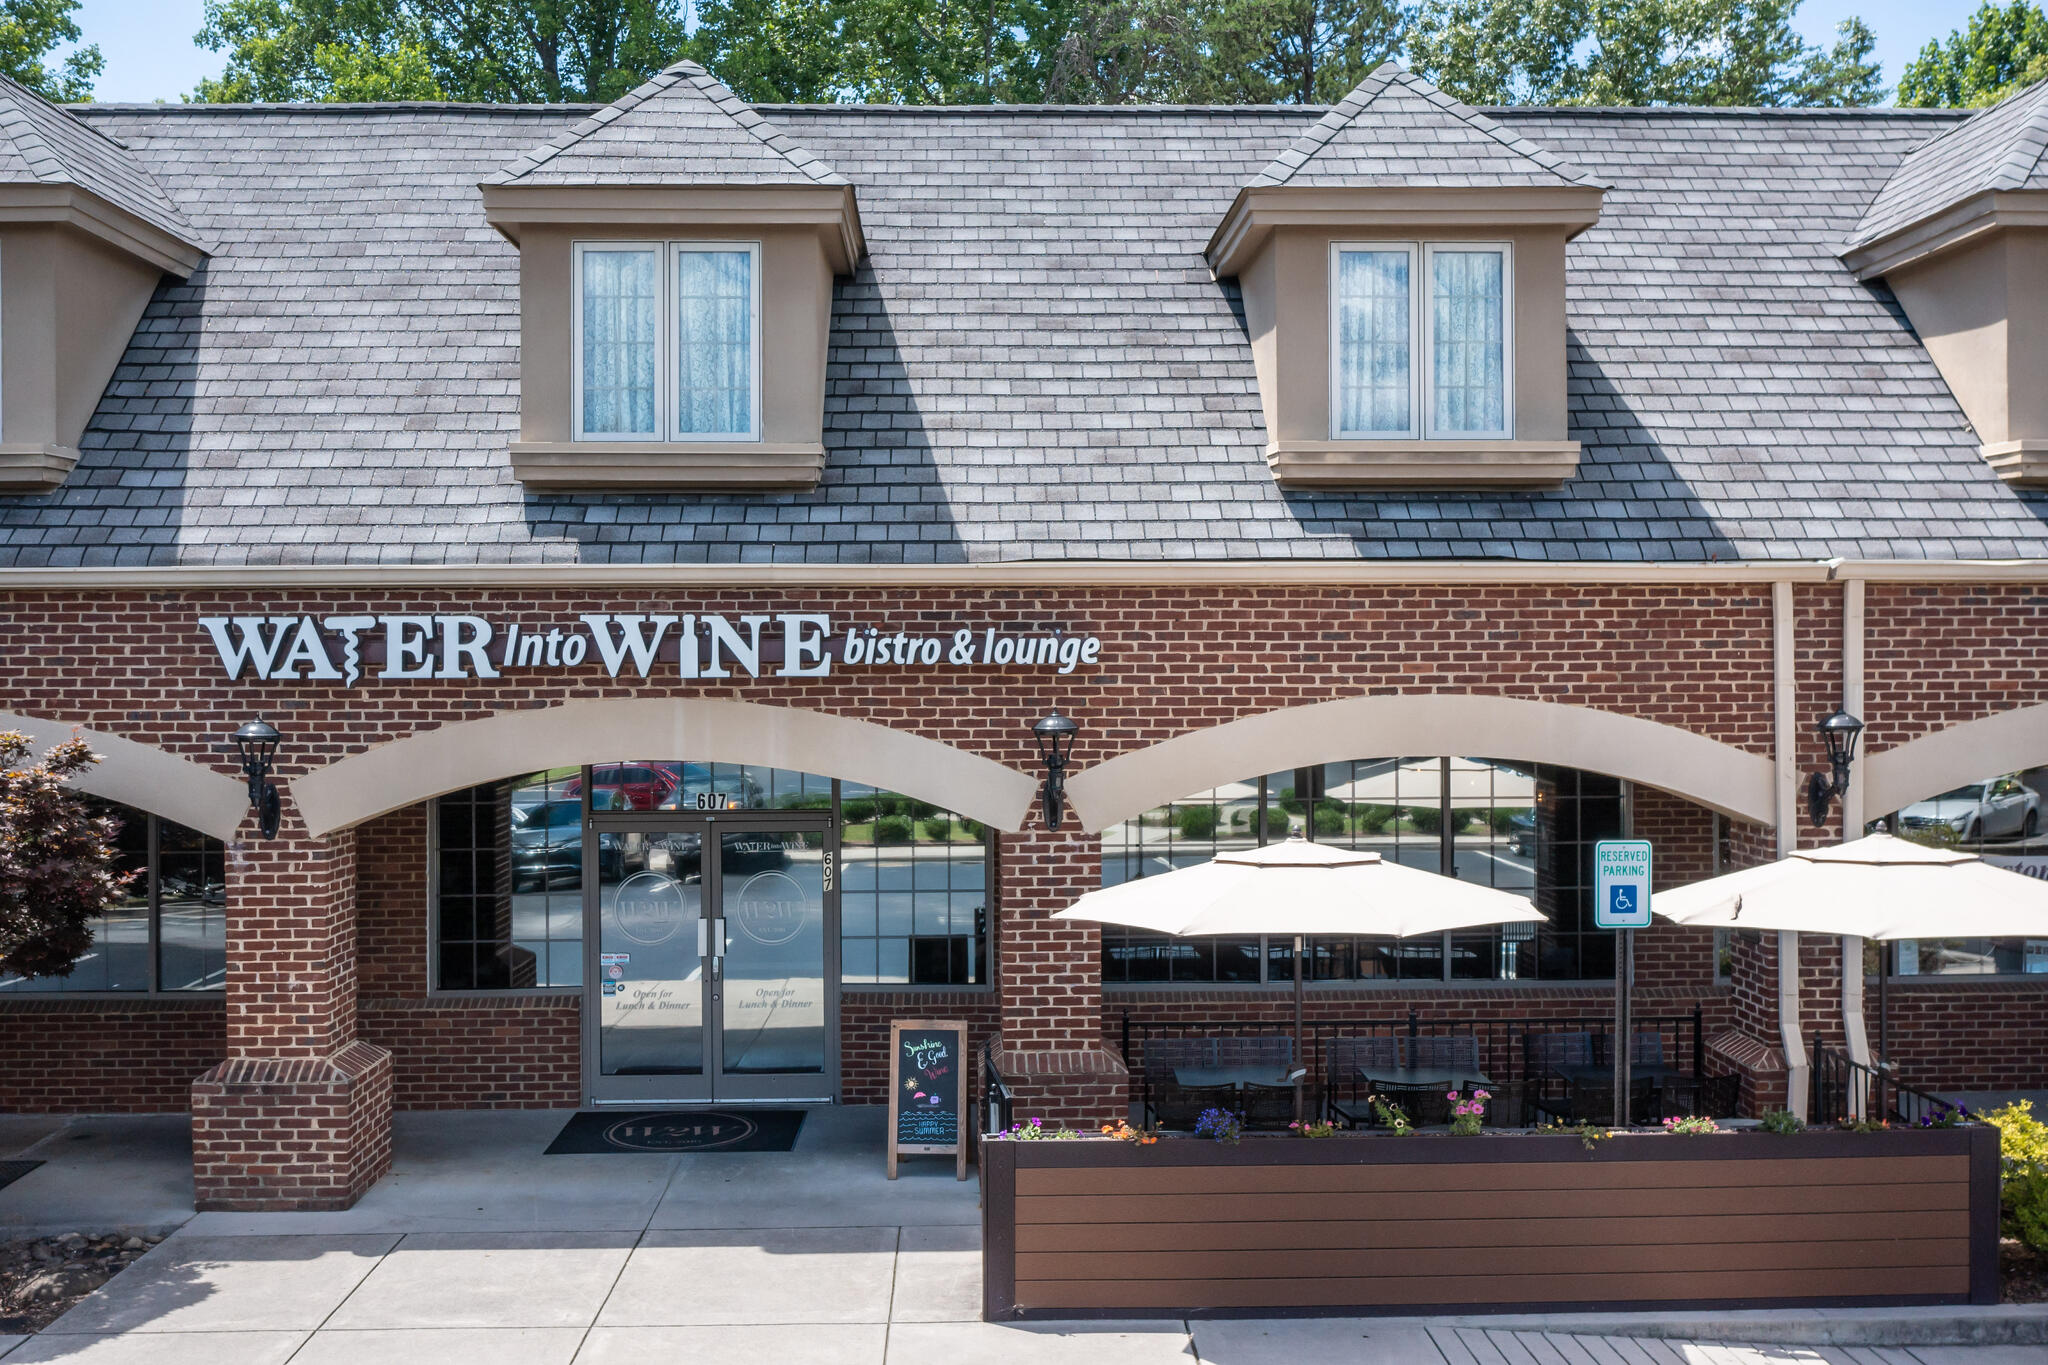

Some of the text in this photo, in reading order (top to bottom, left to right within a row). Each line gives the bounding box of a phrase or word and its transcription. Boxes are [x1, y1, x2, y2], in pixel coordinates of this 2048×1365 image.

[198, 614, 1100, 689] WATER Into WINE bistro & lounge
[697, 793, 727, 810] 607
[734, 841, 771, 851] WATER
[781, 841, 809, 850] WINE
[1600, 850, 1648, 862] RESERVED
[824, 853, 832, 891] 607
[1603, 865, 1645, 876] PARKING
[633, 989, 674, 1000] Open for
[755, 988, 795, 999] Open for
[616, 1001, 690, 1011] Lunch & Dinner
[738, 999, 813, 1009] Lunch & Dinner
[904, 1038, 943, 1058] Sunshine
[914, 1127, 945, 1135] SUMMER
